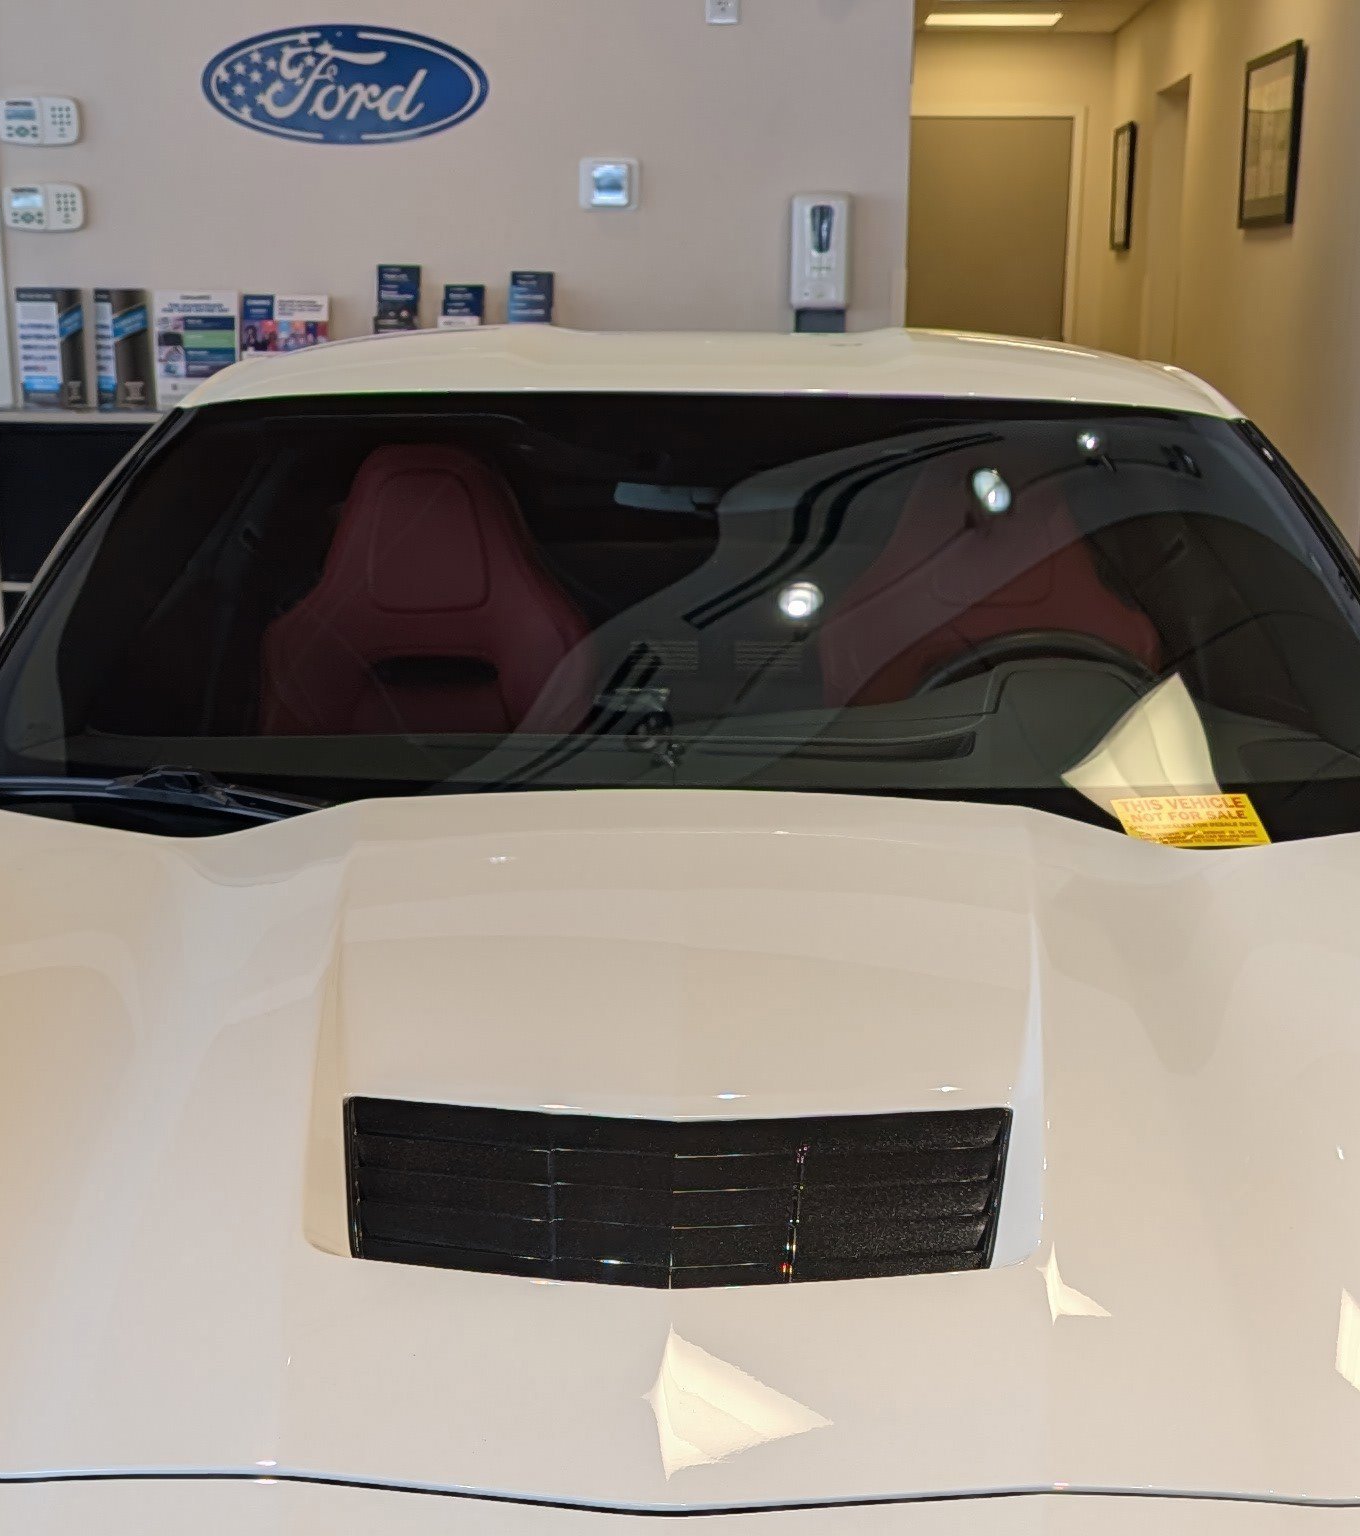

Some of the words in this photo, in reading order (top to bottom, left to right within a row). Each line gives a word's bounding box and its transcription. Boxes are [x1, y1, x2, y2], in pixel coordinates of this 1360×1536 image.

[262, 44, 428, 122] Ford
[1118, 799, 1163, 812] THIS
[1165, 796, 1246, 810] VEHICLE
[1130, 812, 1163, 822] NOT
[1167, 811, 1202, 820] FOR
[1205, 809, 1247, 820] SALE
